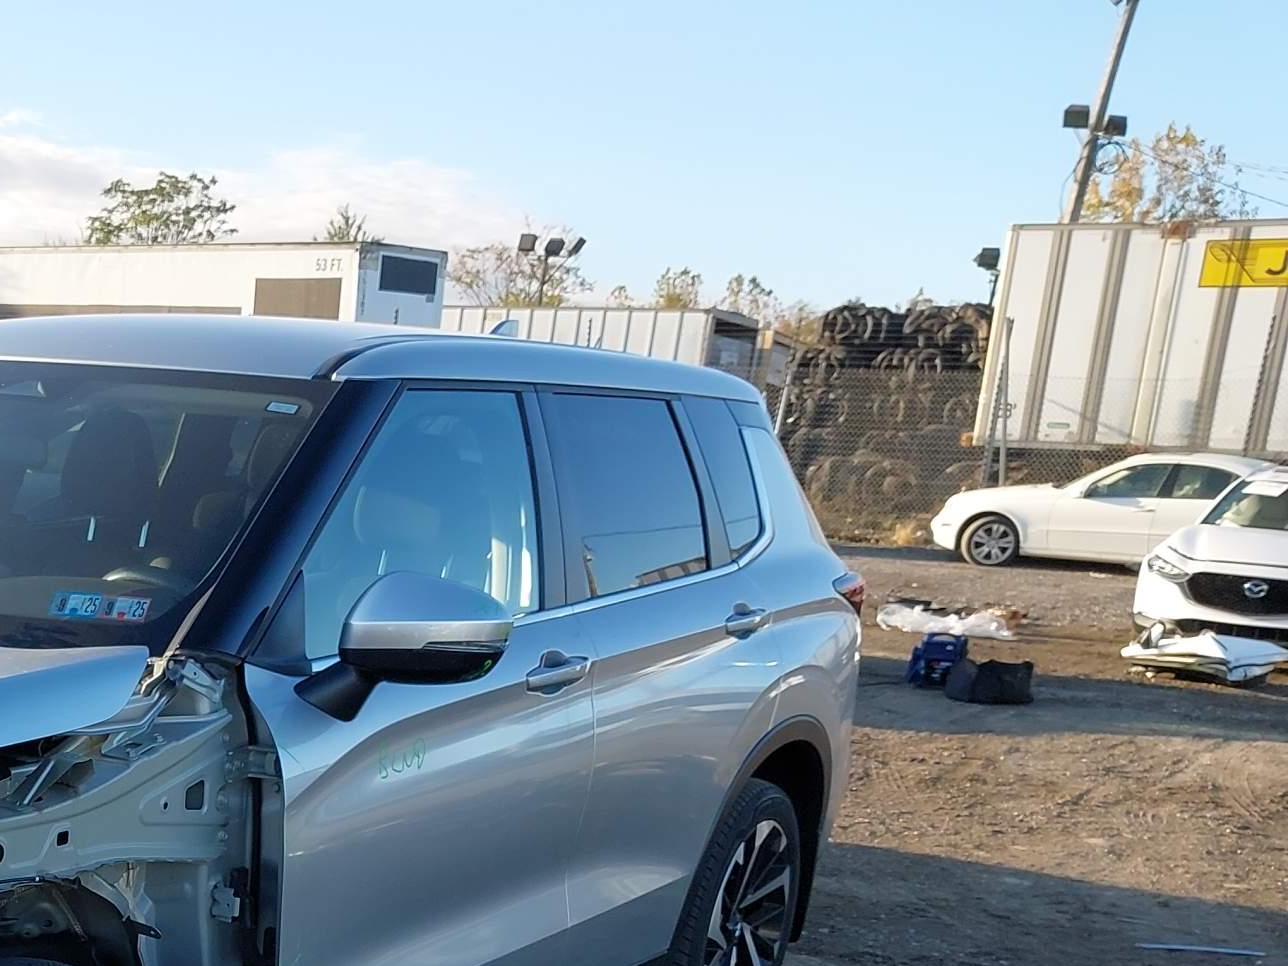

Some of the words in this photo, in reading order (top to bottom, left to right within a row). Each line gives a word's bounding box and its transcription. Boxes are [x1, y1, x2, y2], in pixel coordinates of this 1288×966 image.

[315, 257, 328, 272] 53
[84, 597, 99, 614] 25
[131, 601, 148, 618] 25
